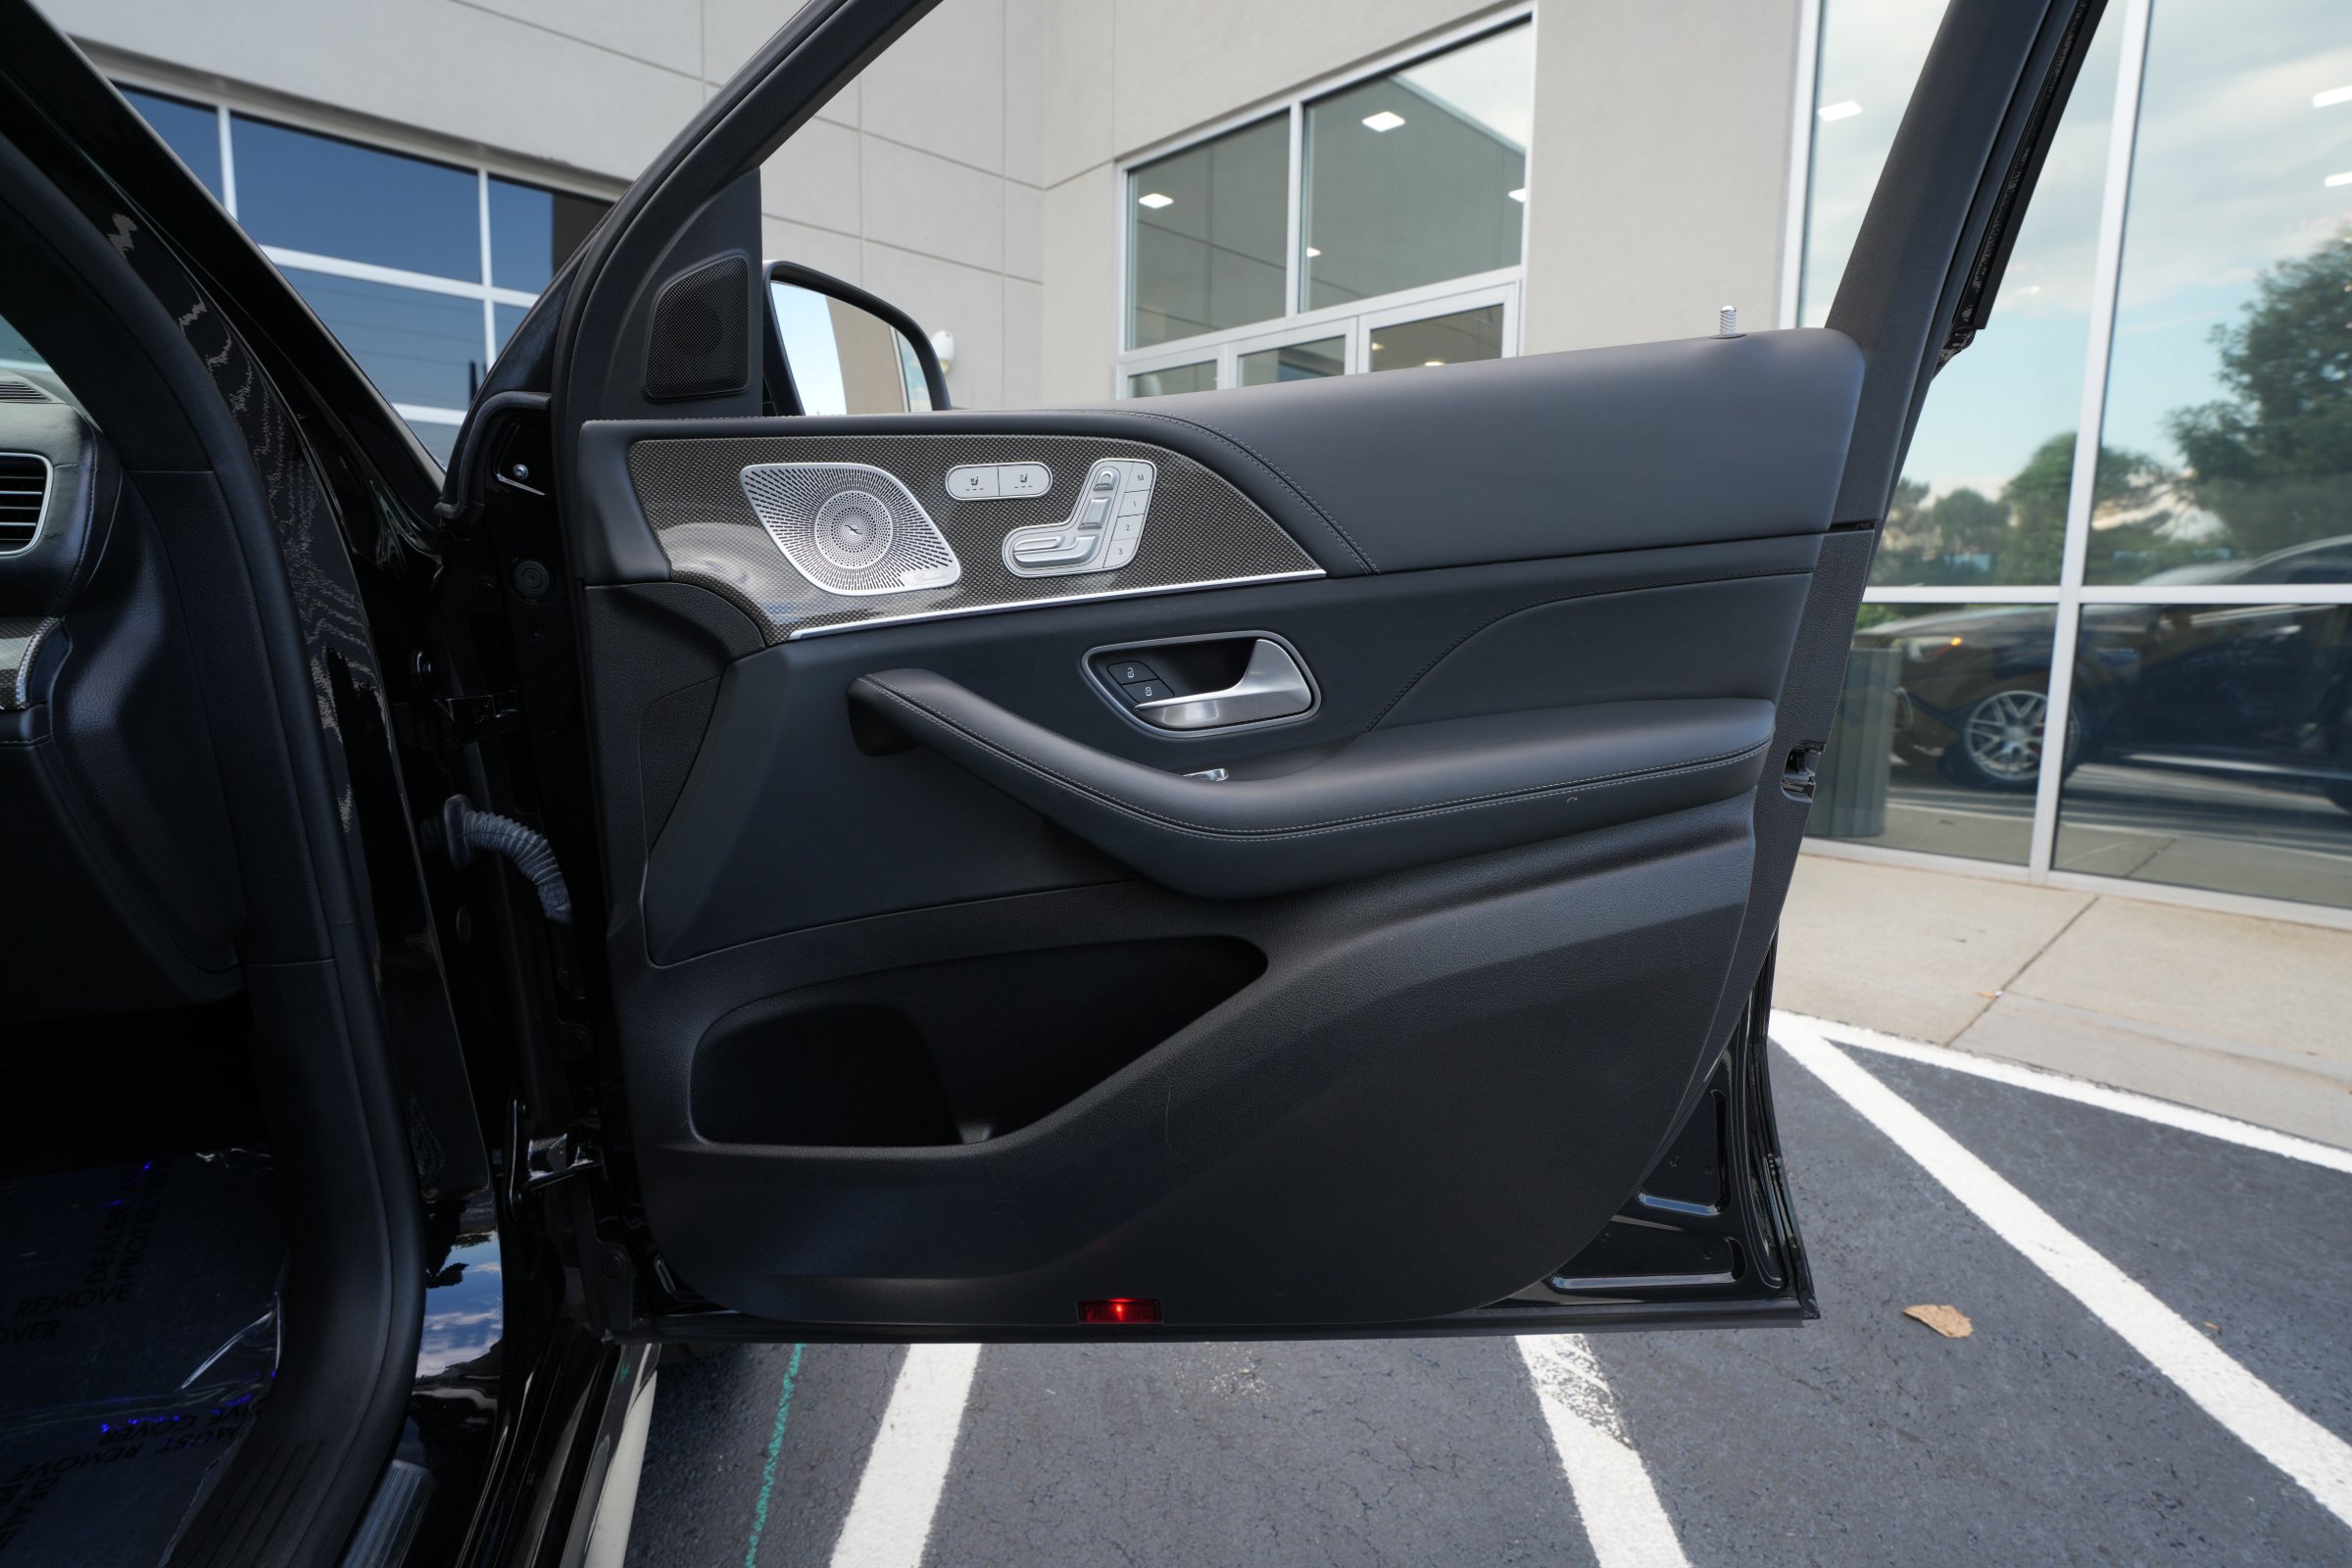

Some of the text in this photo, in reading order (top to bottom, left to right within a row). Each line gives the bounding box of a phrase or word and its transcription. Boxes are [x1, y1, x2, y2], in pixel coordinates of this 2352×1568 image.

[15, 1282, 133, 1317] REMOVE
[98, 1414, 197, 1446] COVER
[9, 1424, 243, 1483] MUST REMOVE
